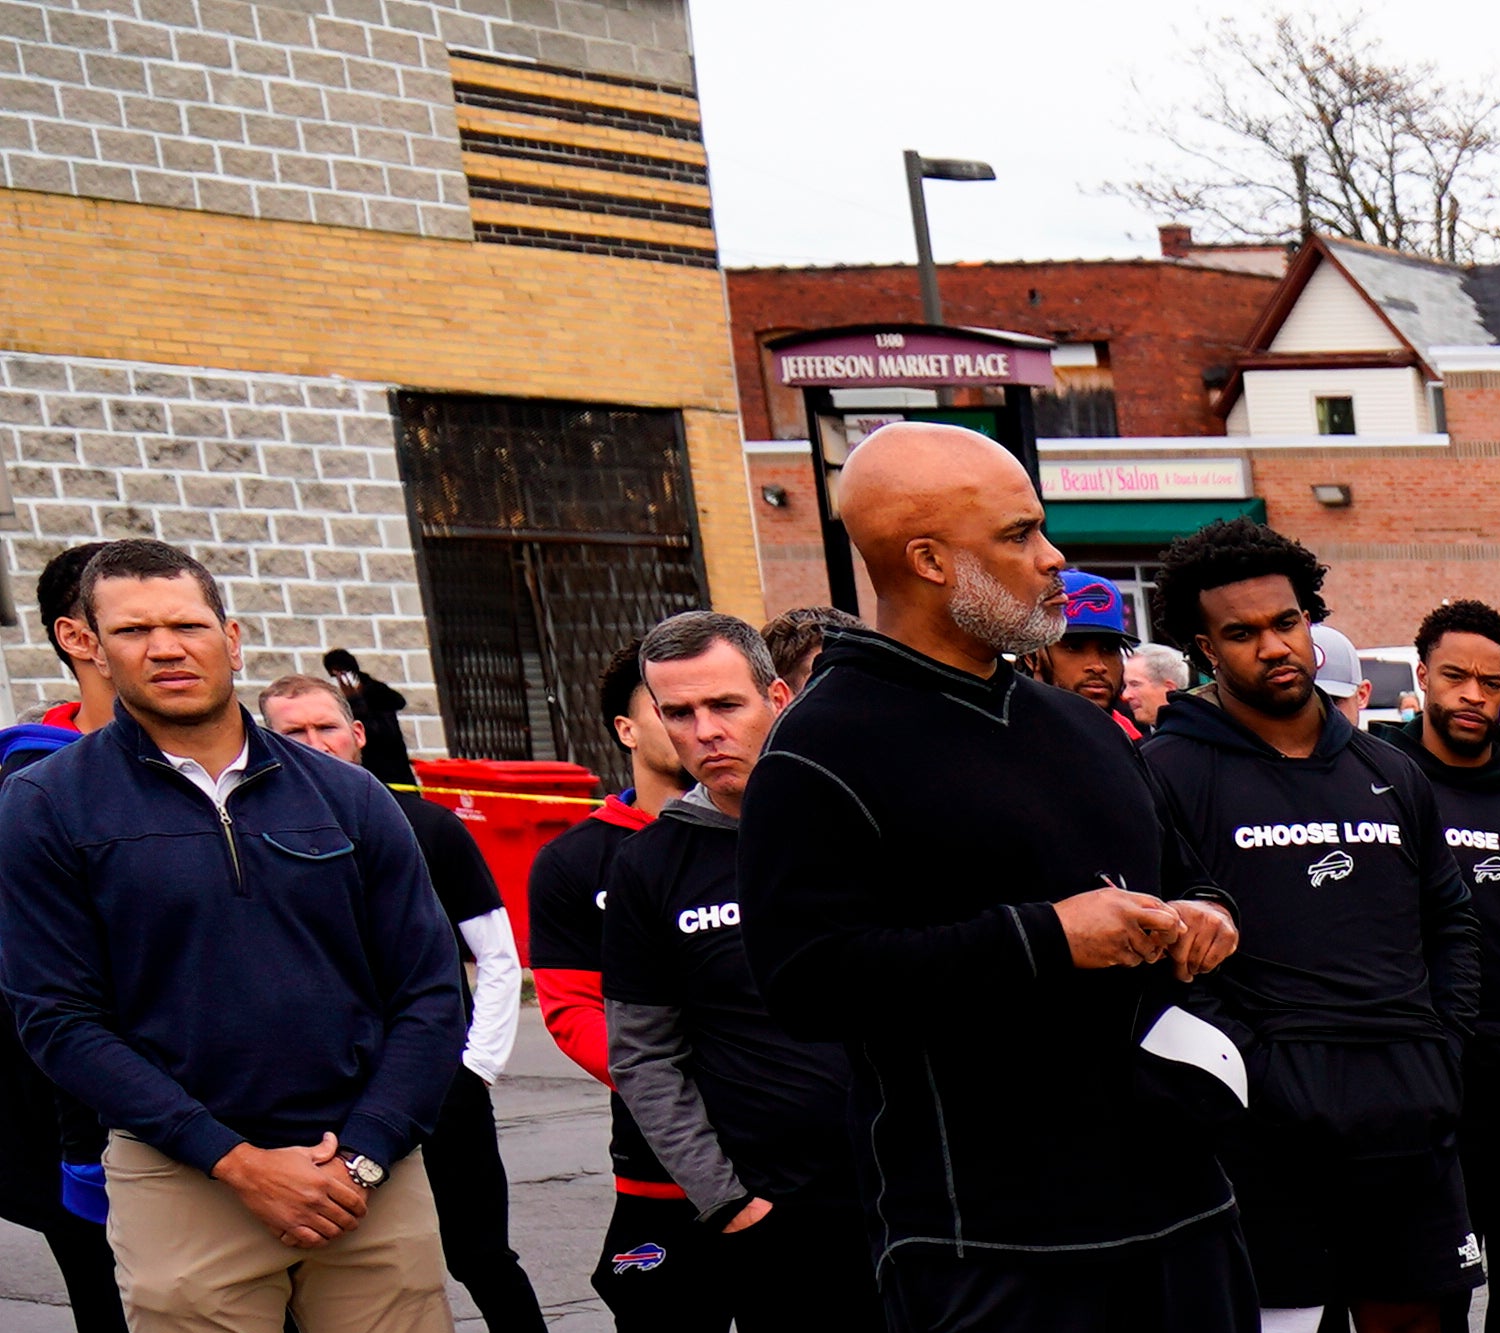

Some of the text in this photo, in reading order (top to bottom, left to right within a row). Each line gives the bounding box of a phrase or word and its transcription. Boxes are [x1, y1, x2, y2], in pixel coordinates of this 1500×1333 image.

[781, 352, 1010, 383] JEFFERSON MARKET PLACE
[1117, 465, 1160, 491] Salon
[1234, 822, 1401, 849] CHOOSE LOVE
[1445, 827, 1499, 850] OOSE
[678, 902, 741, 934] CHO
